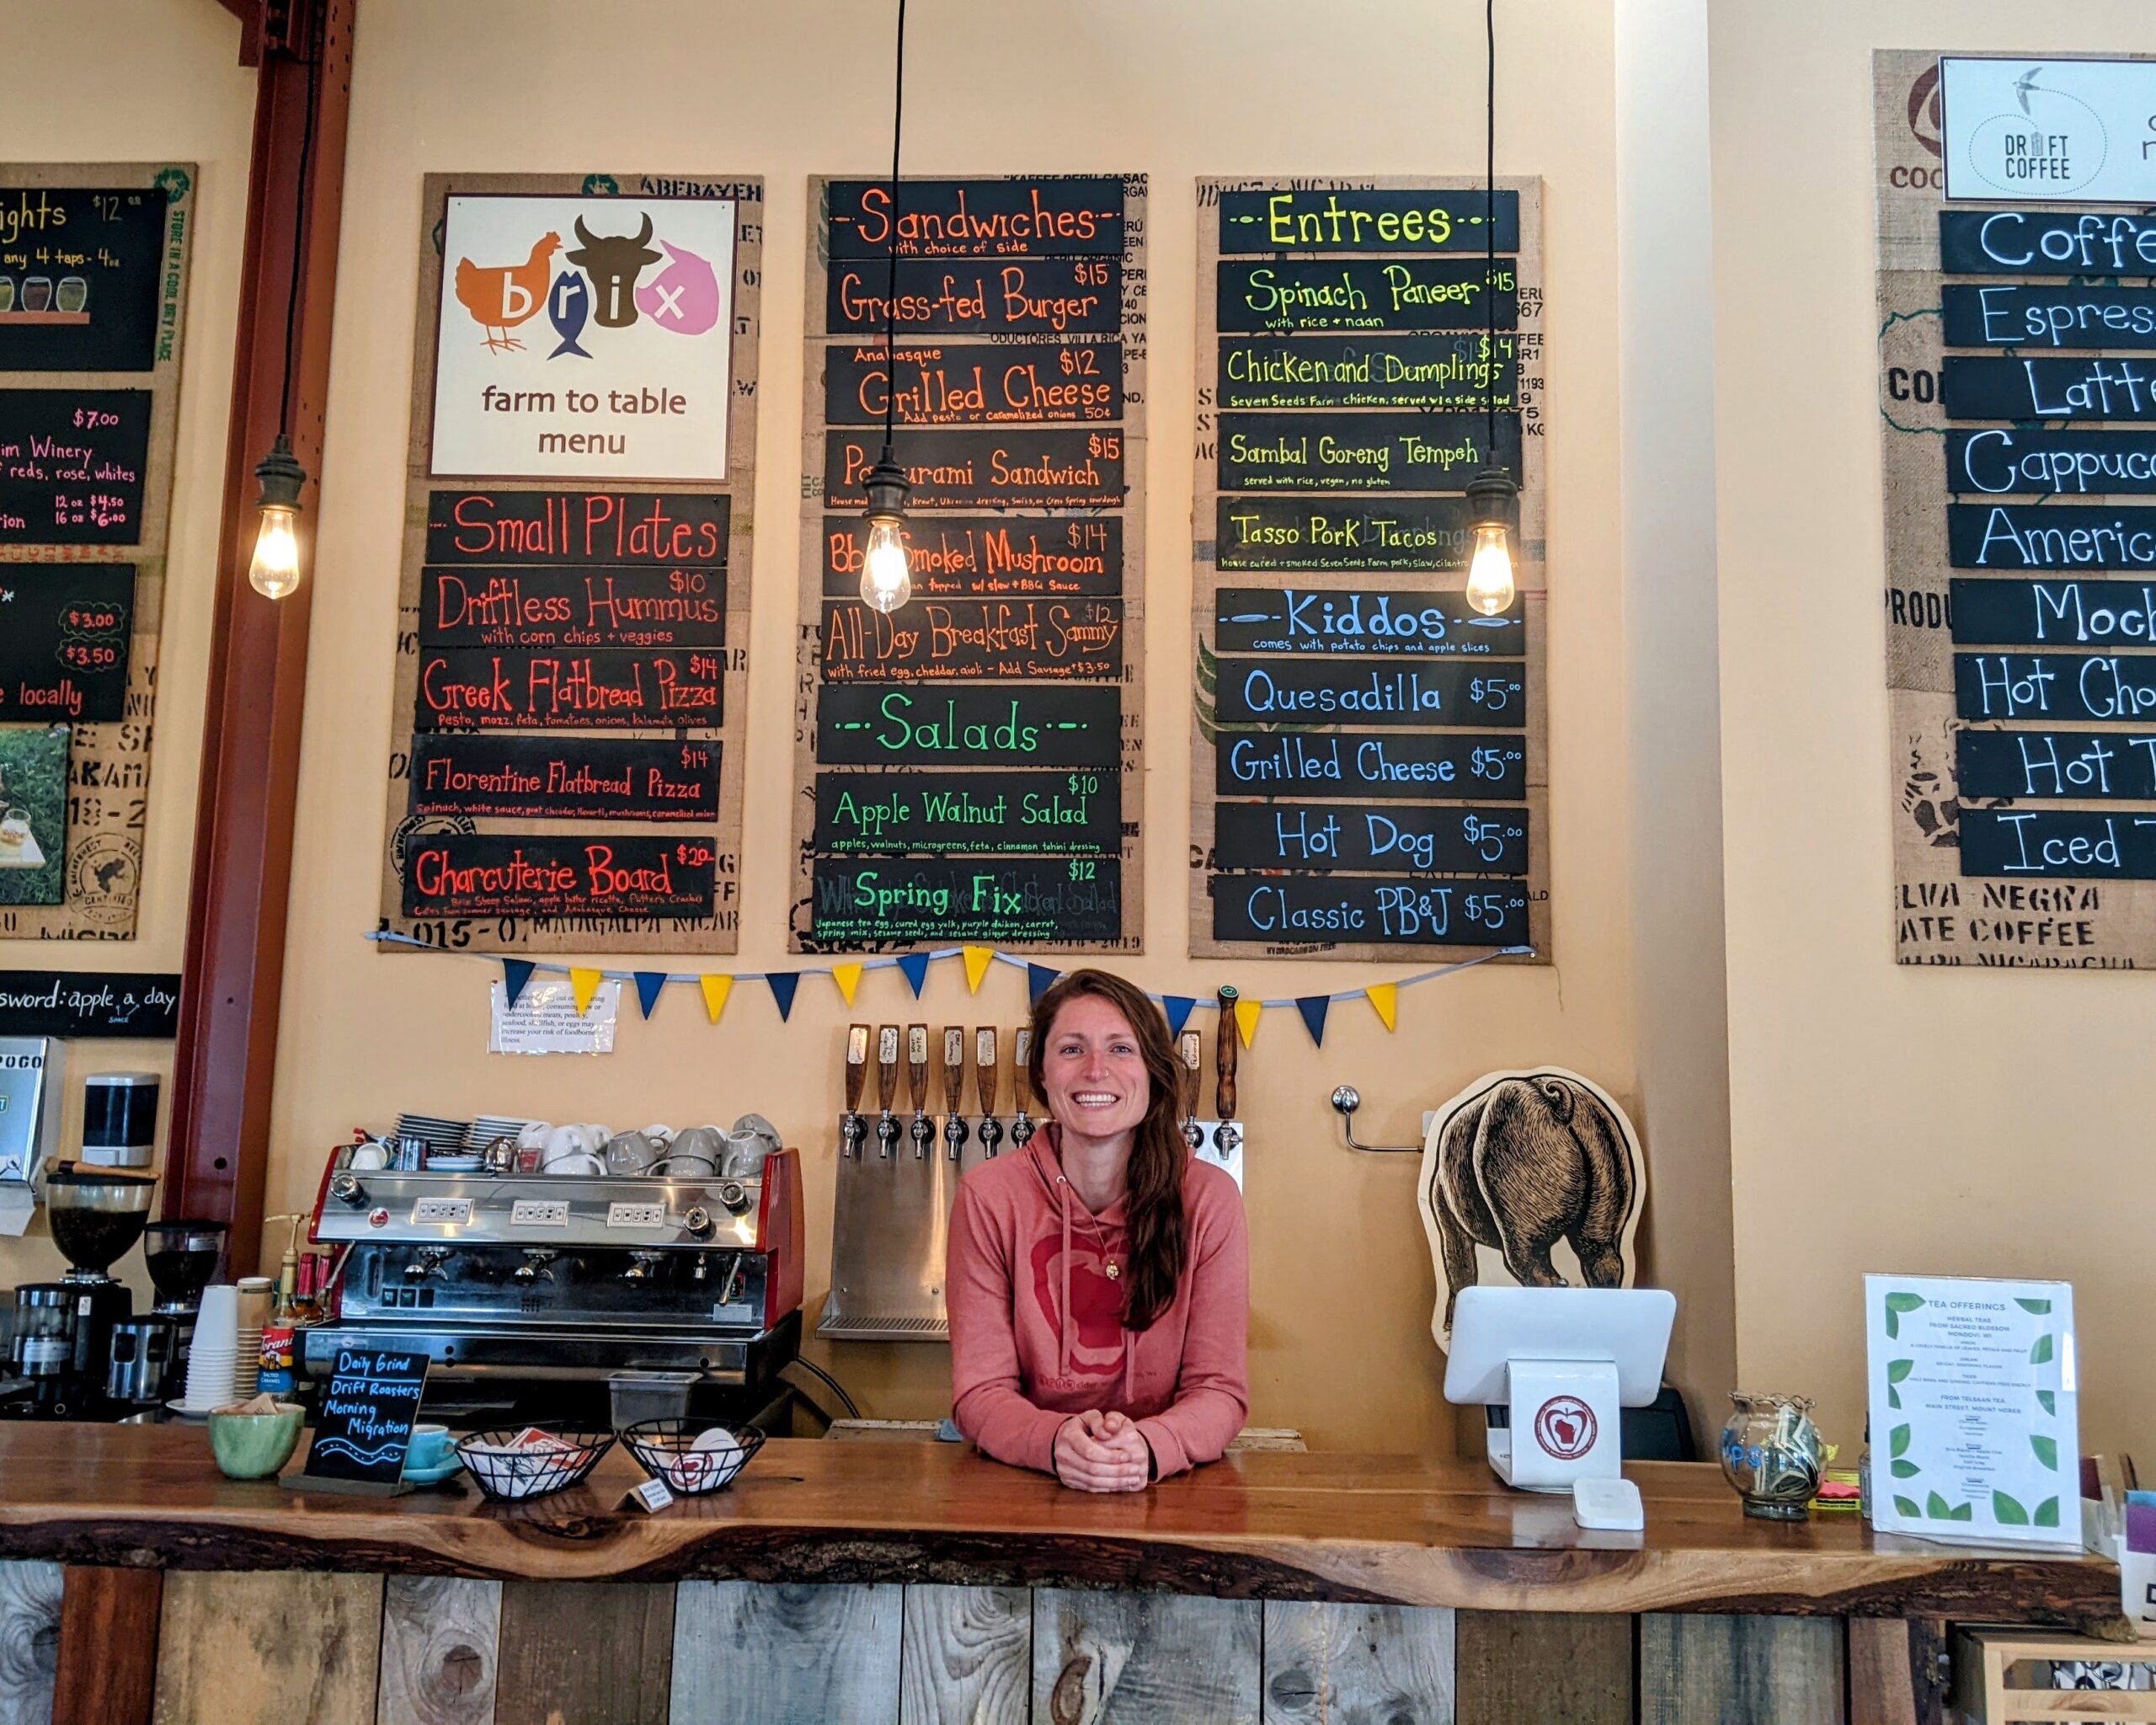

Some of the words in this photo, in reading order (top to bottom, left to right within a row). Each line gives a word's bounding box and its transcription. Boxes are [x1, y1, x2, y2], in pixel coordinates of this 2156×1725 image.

[2006, 158, 2070, 179] COFFEE
[857, 188, 1095, 243] Sandwiches
[1270, 194, 1451, 244] Entrees
[4, 254, 27, 269] any
[36, 248, 50, 264] 4
[925, 240, 967, 254] choice
[973, 241, 988, 253] of
[996, 240, 1028, 253] side
[1074, 262, 1107, 286] $15
[501, 271, 686, 320] brix
[841, 273, 985, 323] Grass-fed
[1001, 267, 1097, 331] Burger
[1245, 269, 1368, 316] Spinach
[1382, 264, 1480, 312] Paneer
[1265, 317, 1294, 328] with
[1299, 316, 1328, 327] rice
[1346, 317, 1384, 328] naan
[1059, 348, 1100, 377] $12
[1227, 349, 1329, 385] Chicken
[1334, 354, 1369, 383] and
[1385, 354, 1503, 390] Dumplings
[482, 385, 555, 412] farm
[566, 389, 599, 414] to
[608, 387, 687, 414] table
[859, 366, 984, 415] Grilled
[1003, 365, 1111, 409] Cheese
[1230, 396, 1268, 407] Seven
[1271, 395, 1305, 407] Seeds
[1310, 396, 1334, 407] Farm
[1392, 396, 1426, 405] served
[1455, 395, 1476, 405] side
[73, 408, 119, 430] $7.00
[904, 411, 927, 423] Add
[932, 411, 961, 423] pesto
[969, 413, 979, 421] or
[986, 409, 1043, 421] caramelized
[31, 435, 92, 467] Winery
[538, 432, 626, 455] menu
[1088, 433, 1120, 460] $15
[1230, 434, 1307, 466] Sambal
[1319, 435, 1390, 473] Goreng
[1399, 435, 1479, 473] Tempeh
[10, 464, 49, 481] reds,
[95, 466, 136, 483] whites
[991, 450, 1100, 486] Sandwich
[1244, 476, 1273, 486] served
[1276, 477, 1294, 485] with
[1297, 477, 1319, 487] rice,
[1321, 478, 1349, 487] vegan,
[1366, 476, 1390, 487] gluten
[56, 494, 68, 509] 12
[90, 494, 124, 509] $4.50
[56, 511, 67, 526] 16
[91, 509, 125, 527] $6.00
[454, 495, 568, 553] Small
[585, 496, 718, 559] Plates
[1230, 515, 1299, 546] Tasso
[1310, 516, 1361, 547] Pork
[1372, 519, 1437, 547] Tacos
[1067, 522, 1107, 552] $14
[985, 529, 1105, 574] Mushroom
[1221, 558, 1246, 568] house
[669, 571, 705, 594] $10
[1049, 580, 1080, 590] Sauce
[438, 575, 571, 629] Driftless
[585, 577, 719, 628] Hummus
[1283, 590, 1446, 639] Kiddos
[69, 610, 114, 628] $3.00
[826, 605, 919, 660] All-Day
[926, 602, 1038, 658] Breakfast
[1045, 605, 1118, 657] Sammy
[481, 630, 514, 644] with
[520, 632, 555, 644] corn
[564, 627, 600, 646] chips
[620, 633, 673, 645] veggies
[1253, 639, 1292, 651] comes
[1299, 639, 1324, 651] with
[1331, 639, 1366, 652] potato
[1372, 640, 1399, 653] chips
[1404, 642, 1424, 653] and
[1428, 642, 1454, 654] apple
[1461, 642, 1490, 653] slices
[67, 645, 115, 665] $3.50
[690, 654, 718, 680] $14
[828, 665, 854, 679] with
[857, 665, 886, 677] fried
[960, 662, 983, 676] aioli
[999, 662, 1022, 676] Add
[20, 679, 82, 715] locally
[424, 659, 512, 713] Greek
[530, 659, 643, 713] Flatbread
[654, 660, 717, 710] Pizza
[1244, 669, 1442, 713] Quesadilla
[1976, 657, 2055, 716] Hot
[877, 692, 1039, 752] Salads
[680, 745, 708, 769] $14
[1230, 738, 1342, 781] Grilled
[1357, 741, 1456, 783] Cheese
[2018, 736, 2114, 794] Hot
[425, 759, 542, 792] Florentine
[547, 761, 632, 796] Flatbread
[648, 768, 701, 798] Pizza
[1068, 773, 1098, 796] $10
[831, 791, 911, 836] Apple
[921, 791, 1007, 825] Walnut
[1021, 793, 1089, 825] Salad
[831, 841, 869, 852] apples,
[912, 841, 969, 852] microgreens,
[997, 841, 1038, 852] cinnamon
[1069, 842, 1100, 854] dressing
[1276, 811, 1341, 859] Hot
[1365, 814, 1435, 868] Dog
[1997, 813, 2121, 871] Iced
[416, 849, 576, 897] Charcuterie
[585, 845, 673, 896] Board
[1068, 859, 1096, 881] $12
[855, 871, 949, 917] Spring
[972, 875, 1022, 916] Fix
[962, 920, 990, 930] purple
[1248, 886, 1365, 931] Classic
[1374, 886, 1453, 937] PB&J
[817, 928, 845, 939] spring
[982, 930, 1008, 939] ginger
[1011, 929, 1050, 939] dressing
[1970, 919, 2095, 946] COFFEE
[144, 987, 176, 1015] day
[1950, 1302, 2006, 1311] OFFERINGS
[262, 1334, 294, 1351] Torani
[339, 1352, 371, 1376] Daily
[376, 1354, 410, 1372] Grind
[331, 1380, 366, 1396] Drift
[369, 1382, 420, 1400] Roasters
[324, 1399, 377, 1418] Morning
[348, 1418, 409, 1437] Migration
